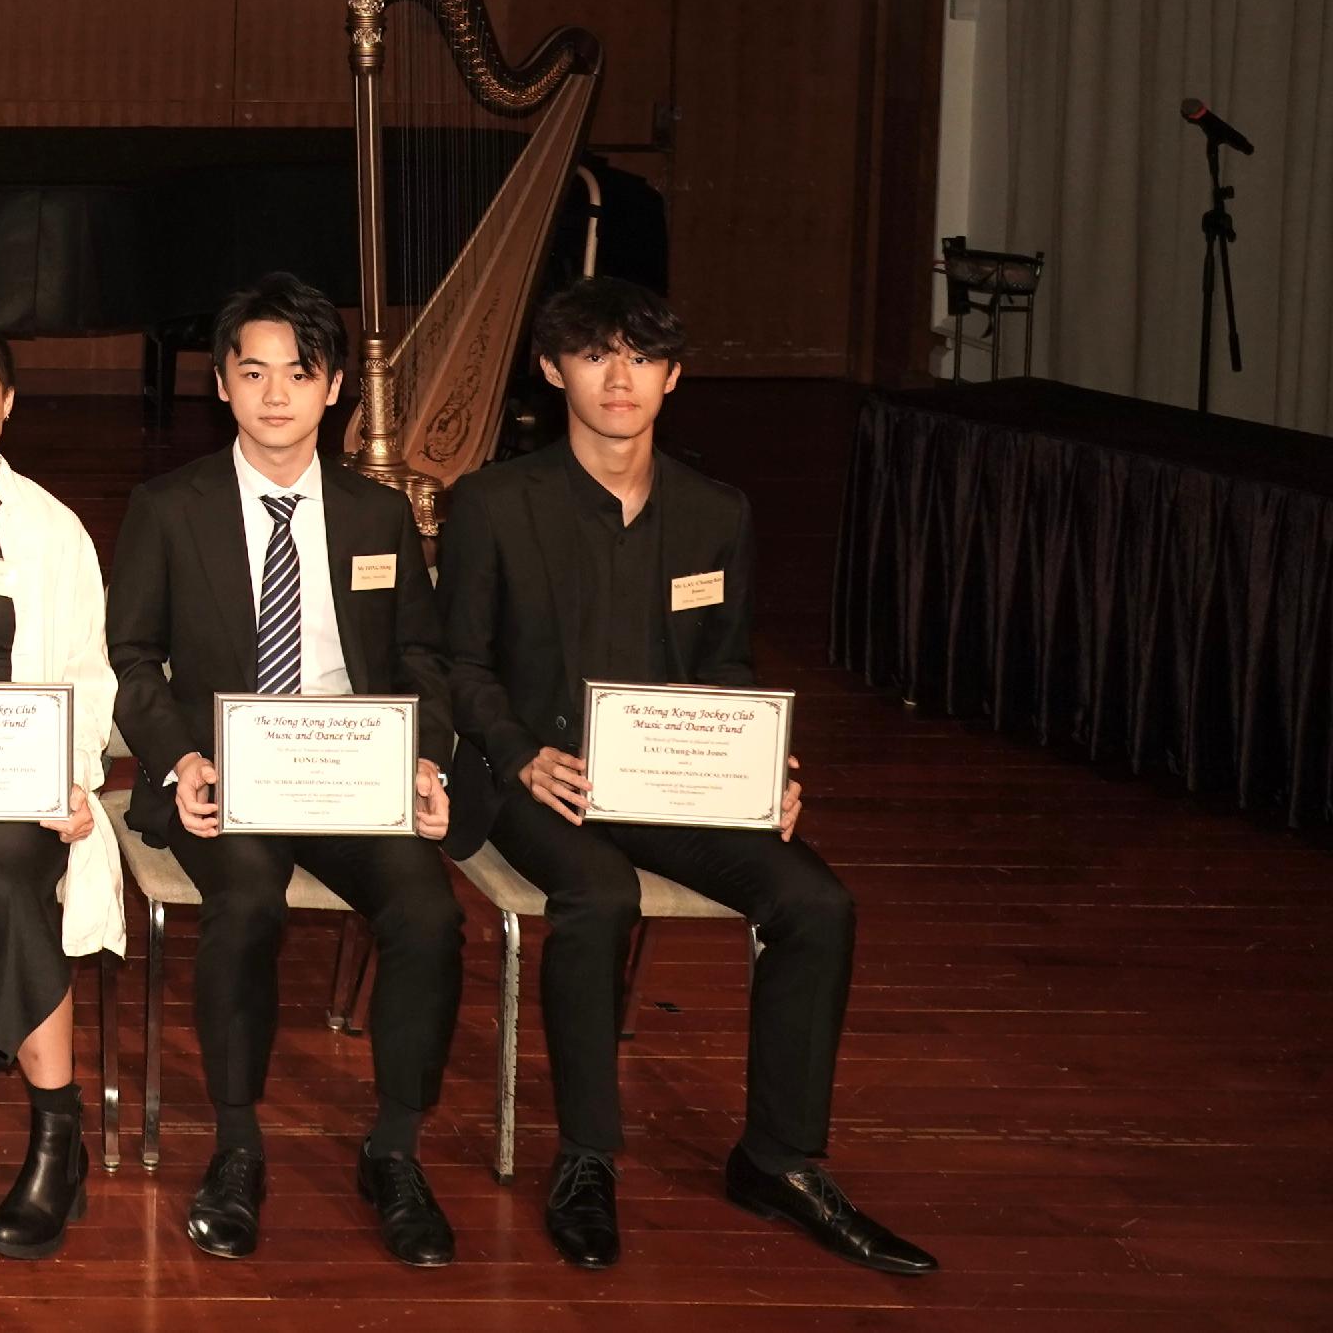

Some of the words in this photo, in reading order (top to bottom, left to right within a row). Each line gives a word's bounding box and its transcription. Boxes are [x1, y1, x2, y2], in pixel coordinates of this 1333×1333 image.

[15, 705, 37, 715] Club
[623, 705, 641, 714] The
[642, 706, 669, 719] Hong
[671, 707, 697, 720] Kong
[698, 709, 730, 721] Jockey
[732, 709, 755, 721] Club
[1, 718, 29, 728] Fund
[253, 716, 272, 726] The
[273, 717, 298, 728] Hong
[300, 717, 326, 728] Kong
[326, 717, 358, 728] Jockey
[359, 717, 381, 727] Club
[632, 720, 661, 729] Music
[664, 720, 684, 731] and
[685, 722, 714, 733] Dance
[717, 723, 746, 734] Fund
[264, 731, 293, 740] Music
[295, 729, 314, 740] and
[315, 732, 344, 741] Dance
[345, 730, 374, 741] Fund
